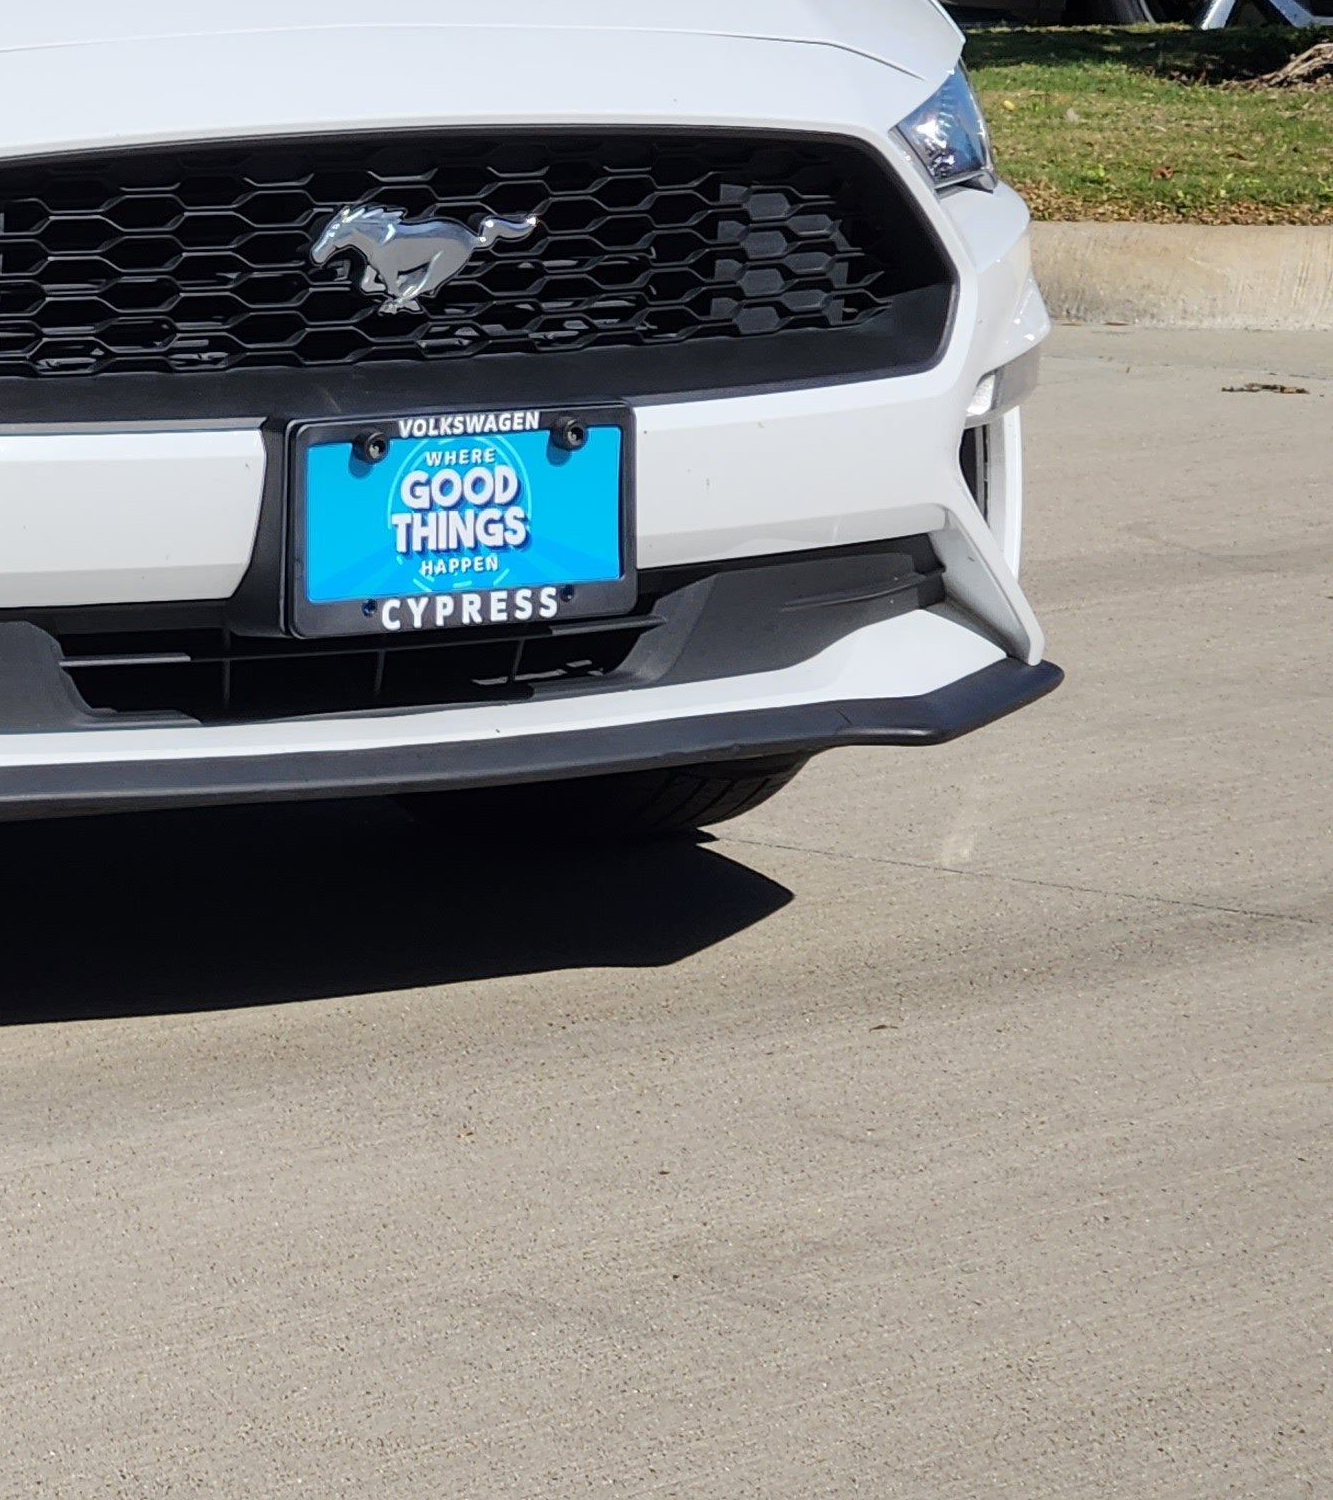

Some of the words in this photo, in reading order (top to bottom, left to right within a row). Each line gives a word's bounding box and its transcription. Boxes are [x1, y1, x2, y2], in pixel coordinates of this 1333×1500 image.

[398, 411, 540, 439] VOLKSWAGEN
[425, 448, 496, 466] WHERE
[400, 465, 520, 510] GOOD
[391, 509, 529, 554] THINGS
[421, 556, 500, 576] HAPPEN
[381, 587, 558, 632] CYPRESS
